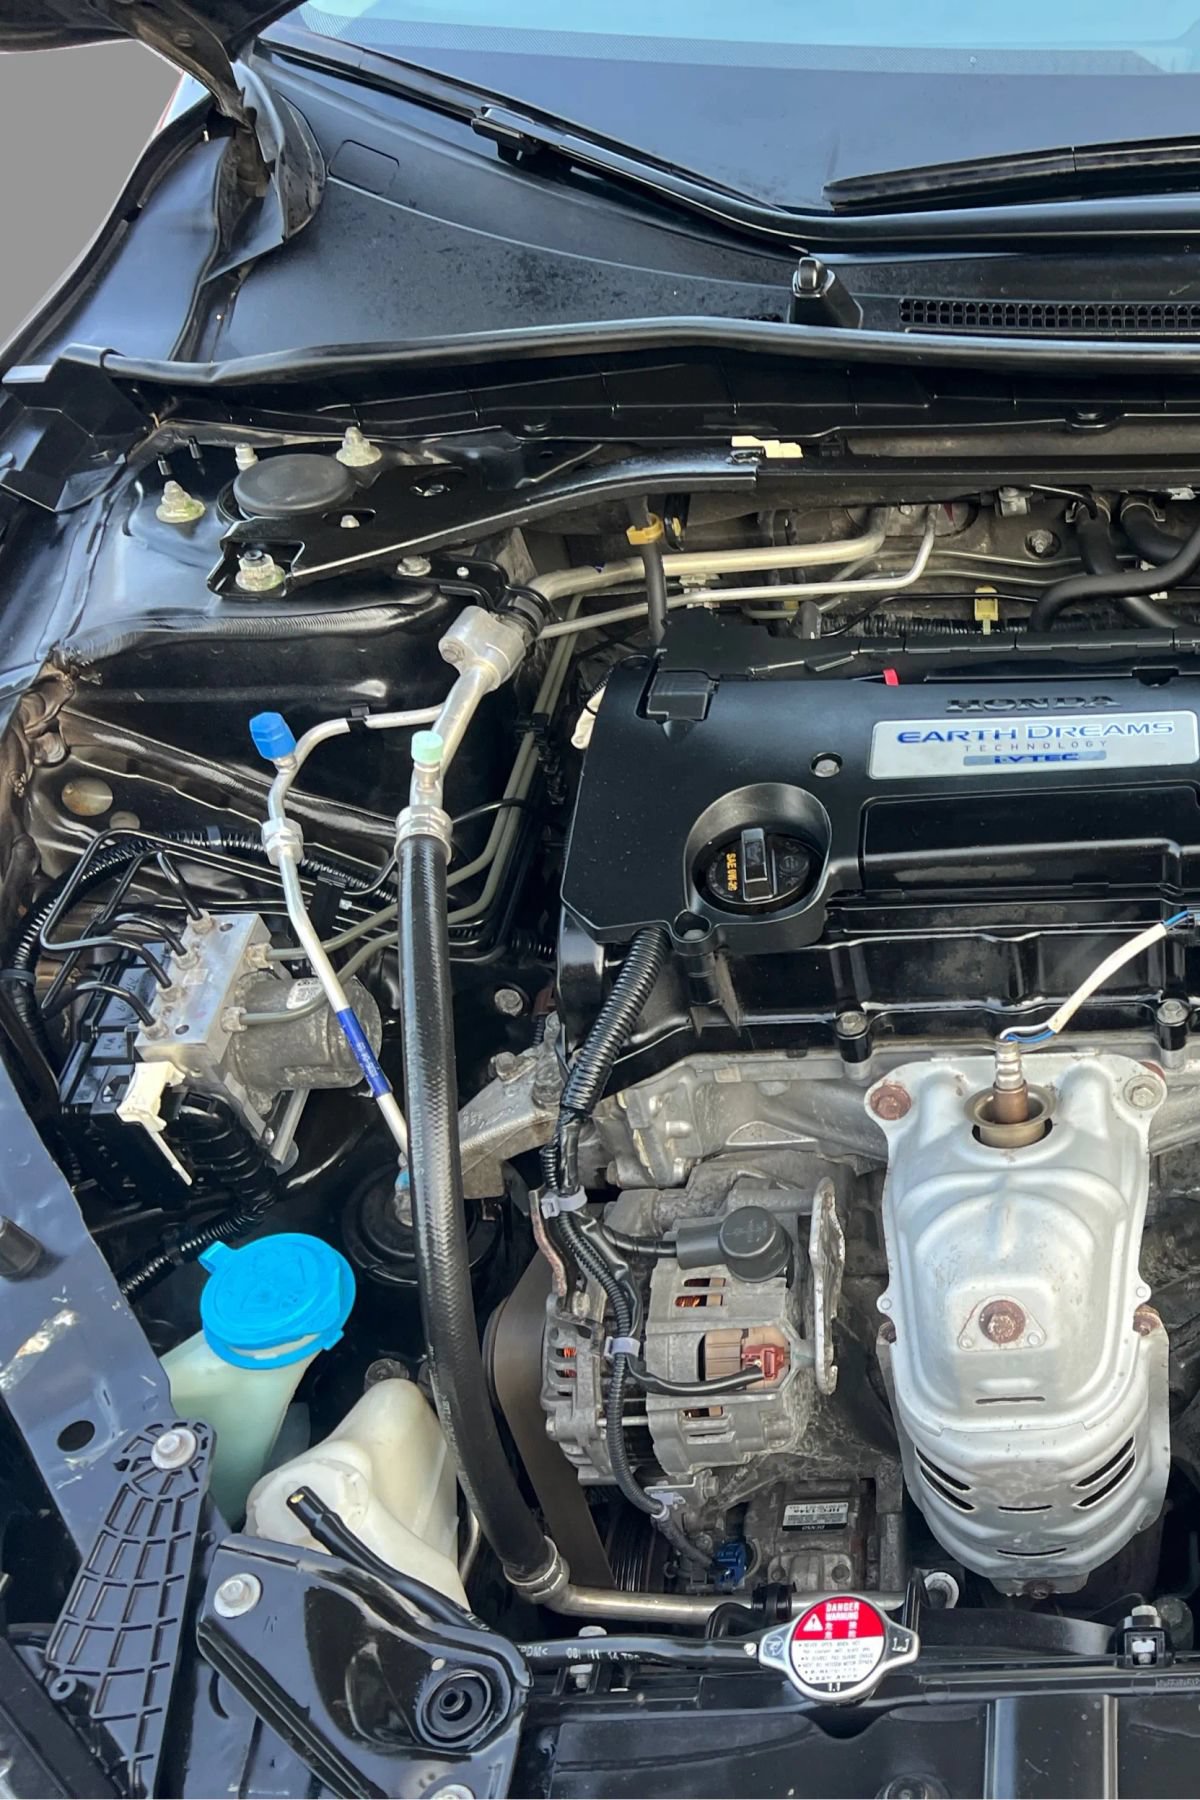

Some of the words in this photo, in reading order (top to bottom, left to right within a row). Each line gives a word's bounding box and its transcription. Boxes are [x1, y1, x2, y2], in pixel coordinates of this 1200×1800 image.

[946, 695, 1122, 712] HONDA
[897, 728, 1016, 744] EARTH
[1027, 721, 1175, 739] DREAMS
[964, 740, 1108, 752] TECHNOLOGY
[725, 853, 737, 868] SAE
[826, 1602, 860, 1612] DANGER
